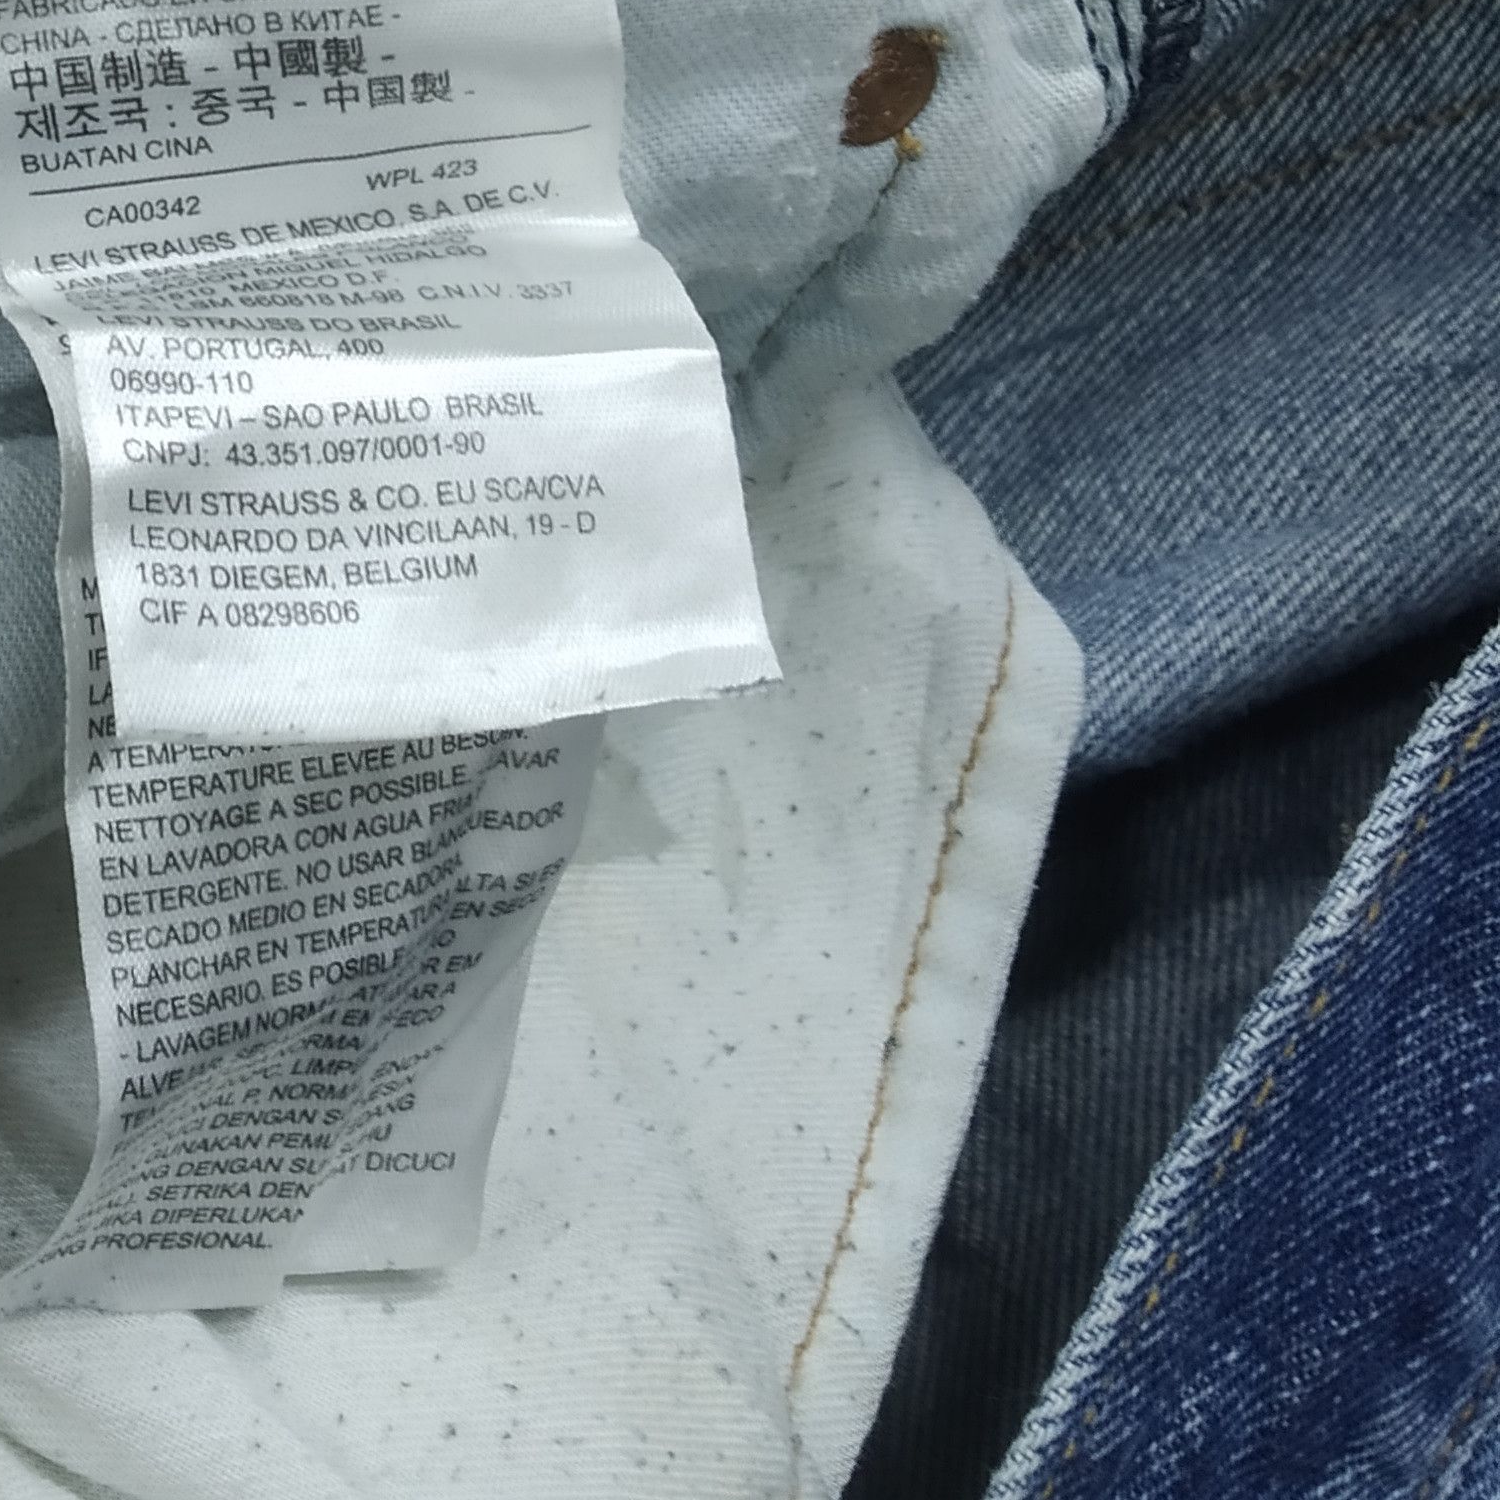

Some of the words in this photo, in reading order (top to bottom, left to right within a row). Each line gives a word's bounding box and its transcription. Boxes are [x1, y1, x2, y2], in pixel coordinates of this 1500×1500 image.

[0, 25, 92, 56] CHINA
[114, 11, 257, 48] СДЕЛАНО
[291, 2, 386, 33] КИТАЕ
[8, 46, 192, 103] 中国制造
[232, 34, 369, 82] 中國製
[190, 84, 277, 128] 중국
[19, 142, 138, 175] BUATAN
[144, 134, 215, 161] CINA
[365, 167, 426, 192] WPL
[430, 158, 480, 181] 423
[33, 249, 100, 275] LEVI
[104, 231, 238, 267] STRAUSS
[240, 223, 283, 248] DE
[463, 188, 506, 214] DE
[84, 194, 203, 229] CA00342
[337, 336, 385, 357] 400
[109, 367, 255, 396] 06990-110
[115, 404, 234, 431] ITAPEVI
[262, 402, 325, 431] SAO
[332, 395, 432, 428] PAULO
[445, 391, 544, 421] BRASIL
[122, 436, 212, 468] CNPJ:
[224, 430, 487, 467] 43.351.097/0001-90
[127, 487, 193, 516] LEVI
[200, 488, 341, 517] STRAUSS
[348, 487, 368, 514] &
[375, 482, 429, 512] CO.
[436, 478, 477, 508] EU
[484, 472, 606, 503] SCA/CVA
[129, 523, 298, 553] LEONARDO
[306, 526, 349, 553] DA
[354, 514, 519, 549] VINCILAAN,
[526, 512, 554, 536] 19
[576, 510, 597, 535] D
[135, 560, 200, 589] 1831
[209, 563, 337, 592] DIEGEM,
[344, 552, 479, 588] BELGIUM
[139, 596, 189, 626] CIF
[197, 601, 219, 628] A
[225, 599, 361, 628] 08298606
[87, 750, 105, 775] A
[87, 759, 296, 810] TEMPERATURE
[300, 744, 398, 782] ELEVEE
[401, 736, 436, 765] AU
[94, 801, 262, 845] NETTOYAGE
[268, 798, 288, 822] A
[292, 787, 344, 818] SEC
[99, 855, 139, 881] EN
[147, 832, 290, 877] LAVADORA
[294, 820, 348, 852] CON
[352, 808, 424, 842] AGUA
[102, 868, 289, 919] DETERGENTE.
[296, 858, 332, 887] NO
[337, 844, 406, 879] USAR
[105, 916, 222, 955] SECADO
[227, 898, 306, 937] MEDIO
[312, 890, 347, 920] EN
[110, 945, 252, 991] PLANCHAR
[256, 936, 289, 966] EN
[271, 968, 304, 998] ES
[136, 1015, 251, 1064] LAVAGEM
[208, 1107, 319, 1131] DENGAN
[175, 1156, 285, 1179] DENGAN
[365, 1150, 457, 1173] DICUCI
[145, 1180, 252, 1203] SETRIKA
[90, 1231, 274, 1252] PROFESIONAL.
